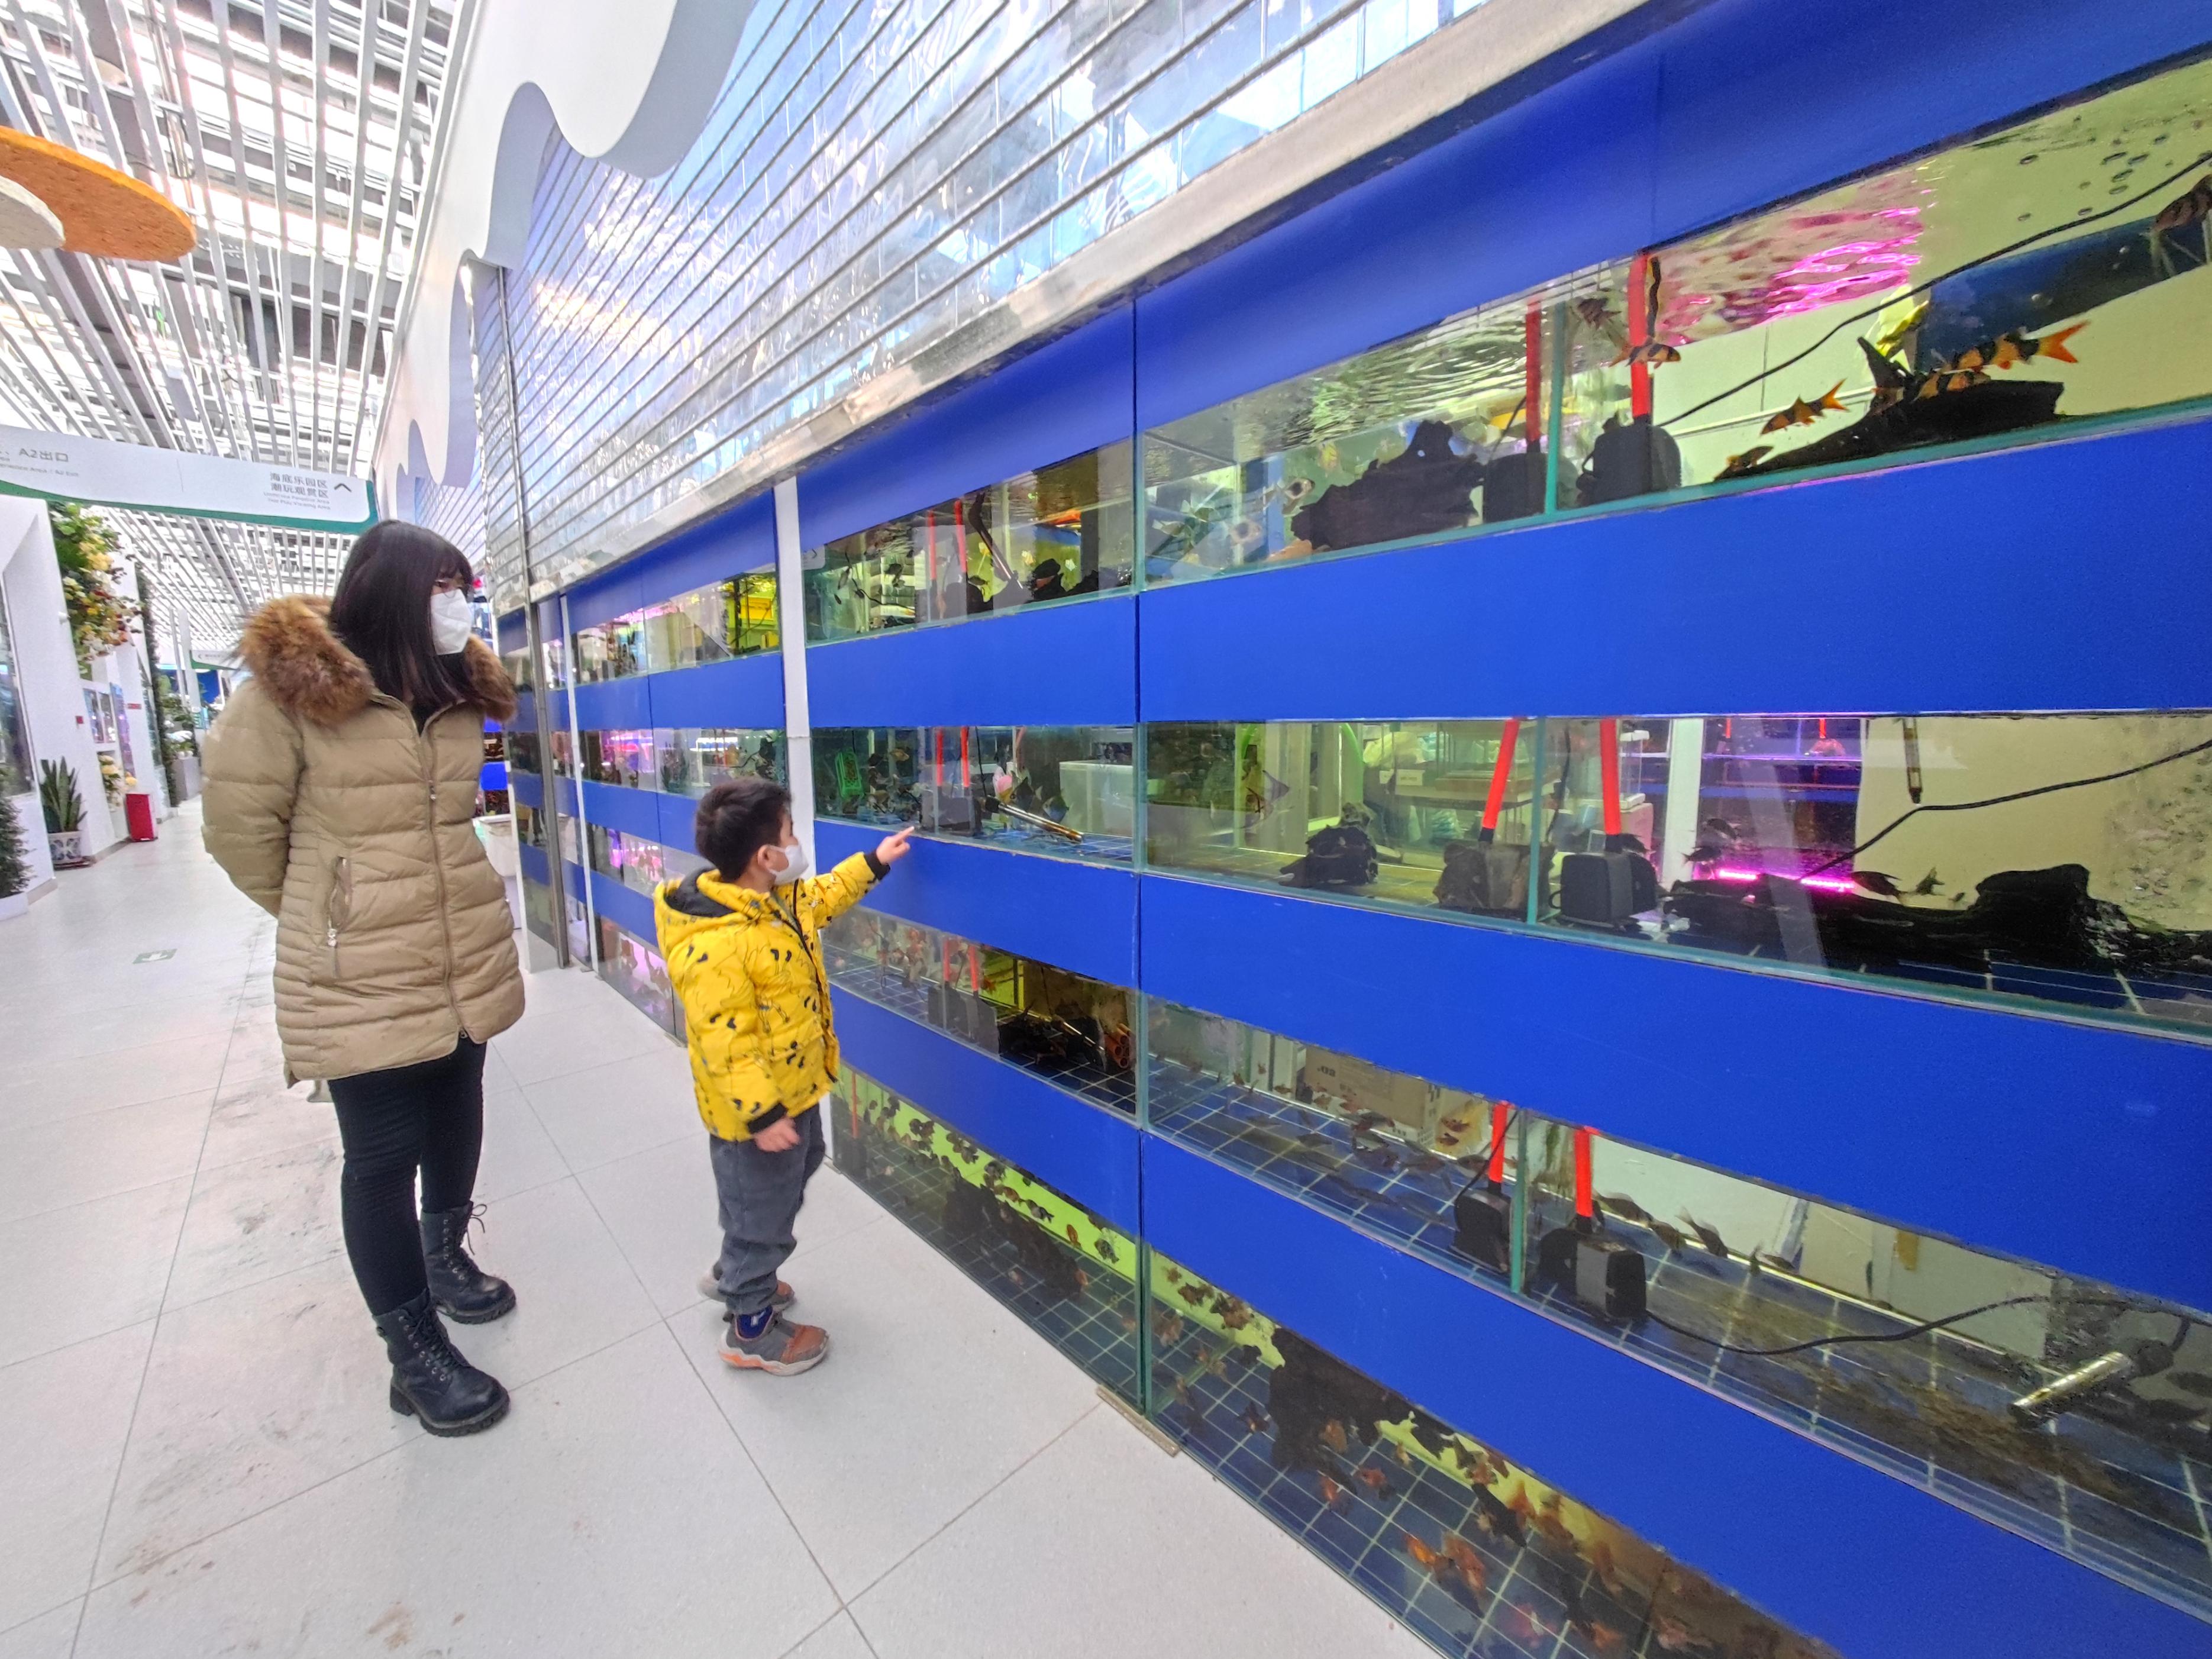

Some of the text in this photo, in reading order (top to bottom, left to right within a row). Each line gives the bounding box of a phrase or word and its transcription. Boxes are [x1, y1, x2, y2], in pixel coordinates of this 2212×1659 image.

[270, 472, 328, 488] 海底乐园区
[270, 482, 328, 498] 潮玩观赏区
